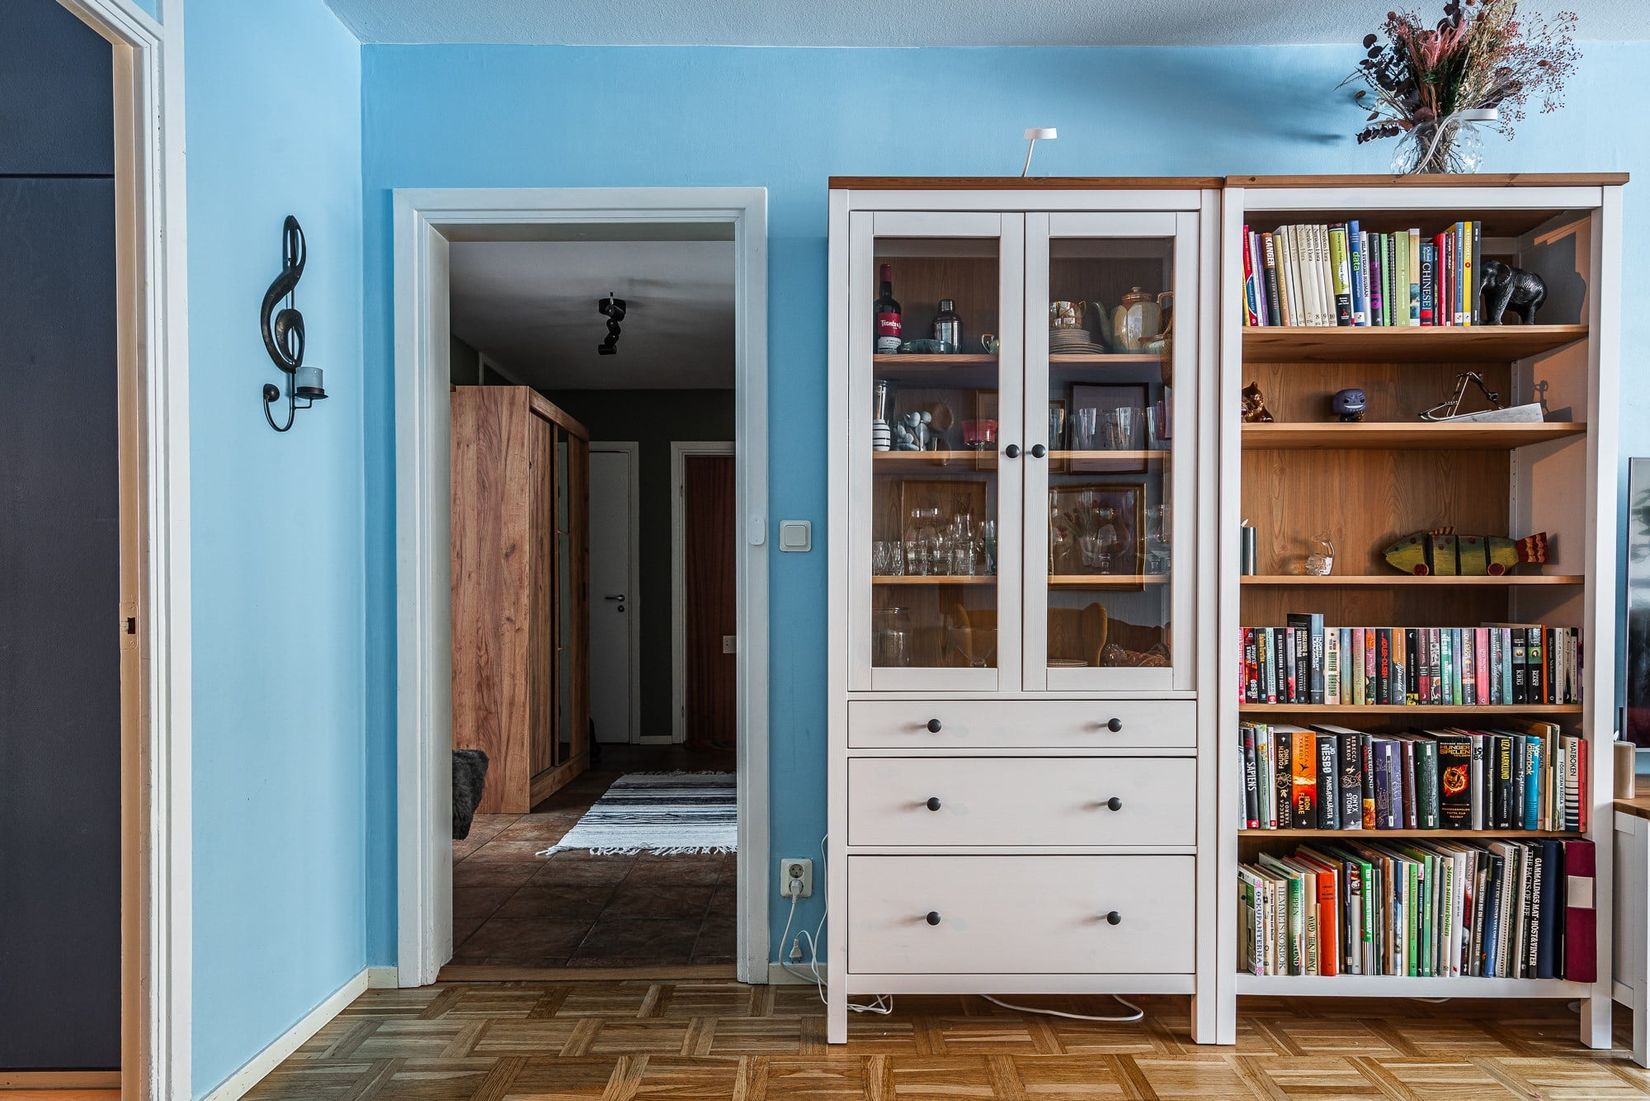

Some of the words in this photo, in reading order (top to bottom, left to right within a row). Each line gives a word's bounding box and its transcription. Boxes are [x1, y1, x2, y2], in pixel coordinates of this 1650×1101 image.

[1265, 237, 1275, 266] KANGER
[1422, 263, 1431, 307] CHINESE
[1321, 744, 1331, 773] NESBØ
[1501, 739, 1510, 750] LIZA
[1246, 762, 1256, 791] SAPIENS
[1501, 751, 1510, 780] MARKLUND
[1524, 890, 1531, 900] OF
[1532, 858, 1542, 903] GAMMALDAGS
